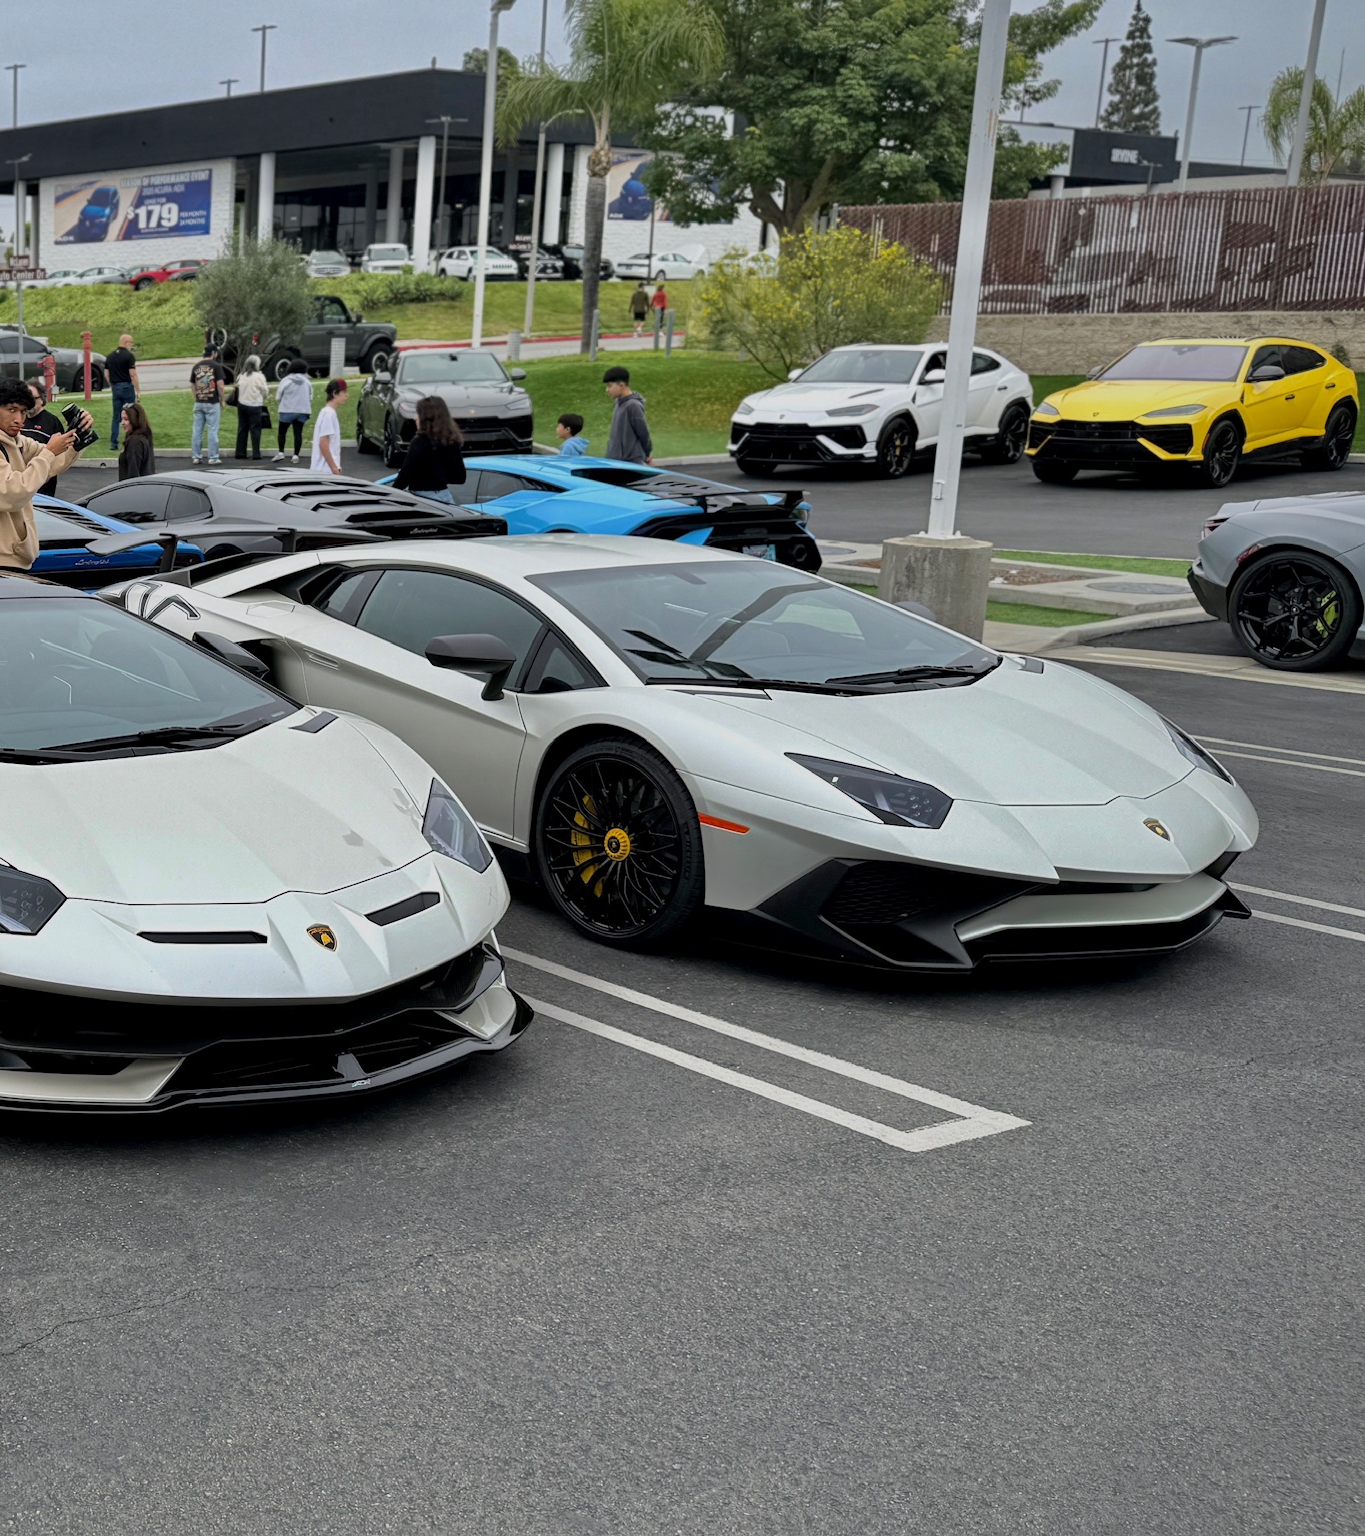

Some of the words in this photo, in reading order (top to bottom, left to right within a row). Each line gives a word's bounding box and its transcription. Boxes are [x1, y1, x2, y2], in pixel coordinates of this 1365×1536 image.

[1111, 148, 1139, 164] IRVINE
[150, 171, 190, 185] PERFORMANCE
[190, 169, 210, 182] EVENT
[154, 184, 173, 195] ACURA
[11, 270, 35, 280] Center
[36, 269, 45, 279] Dr
